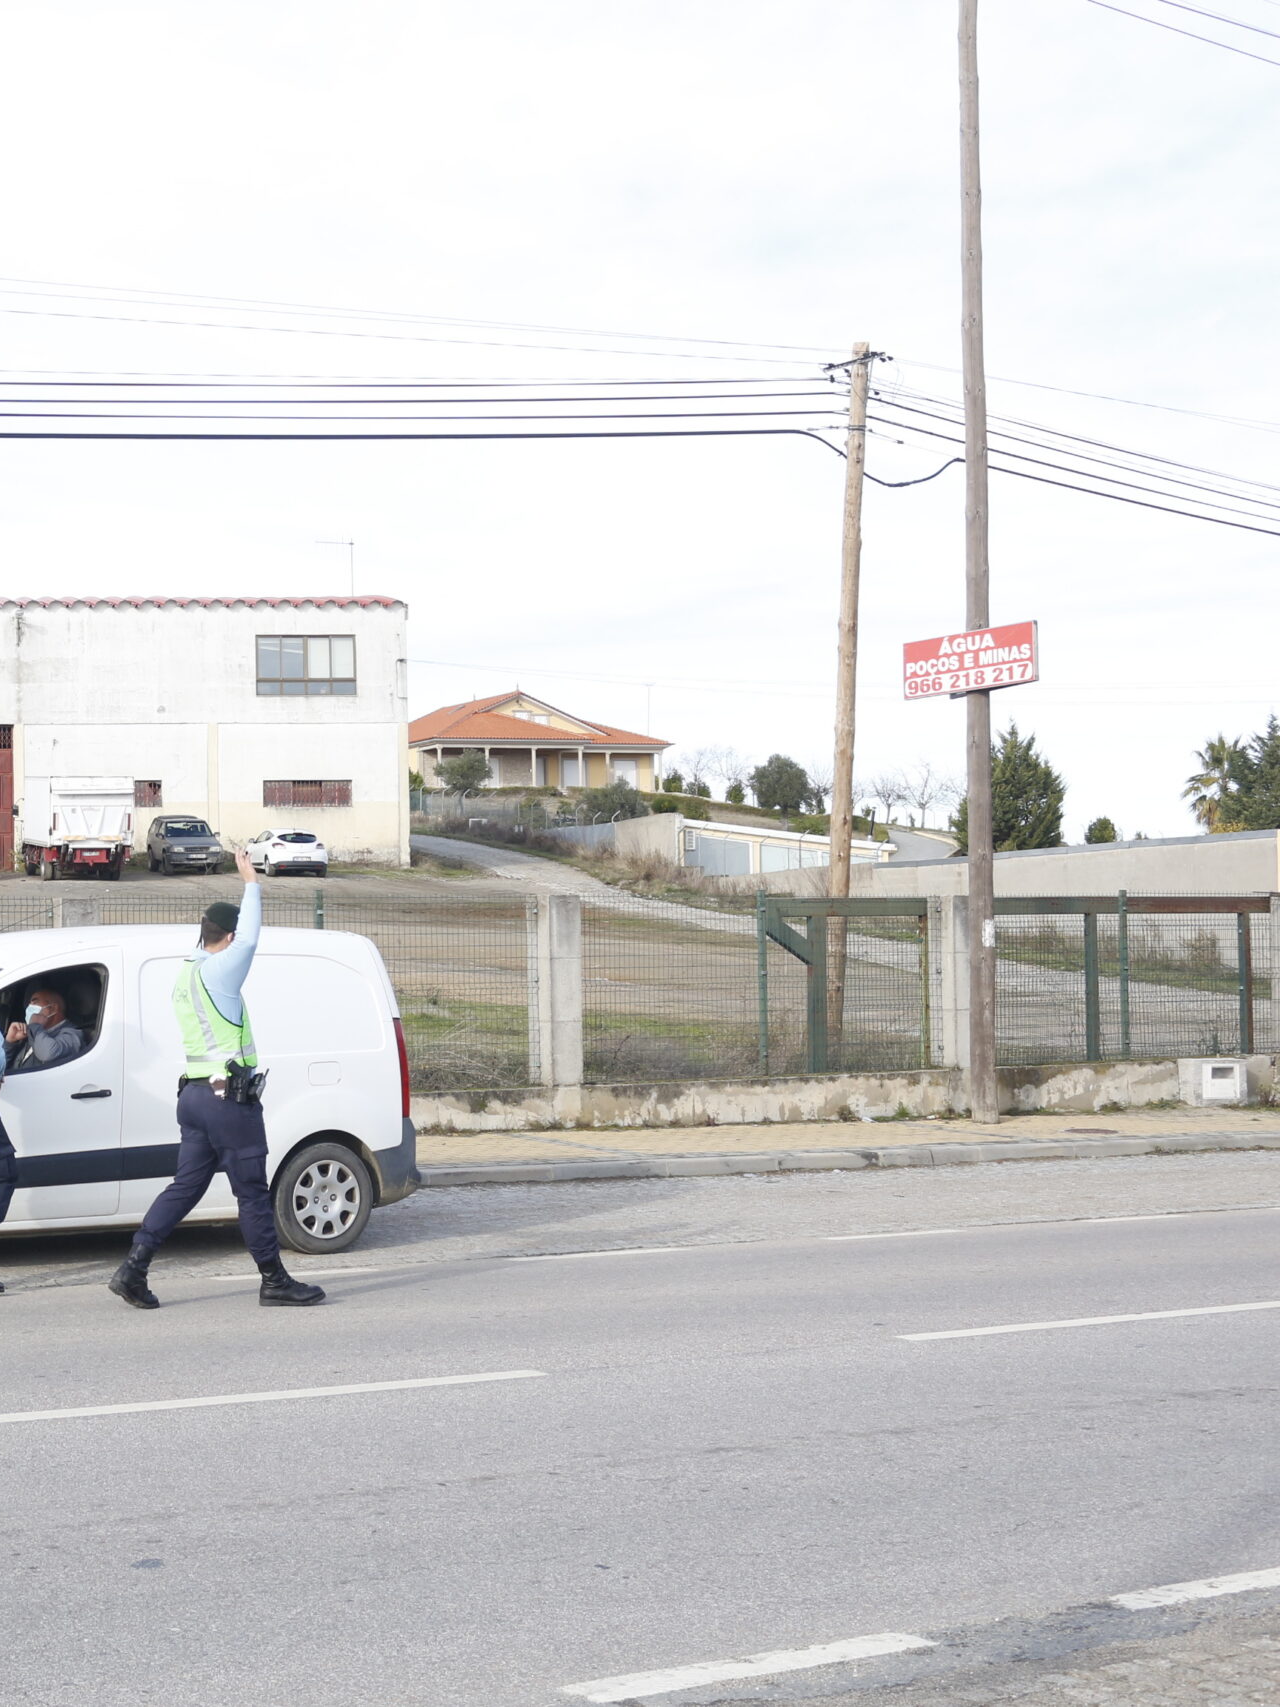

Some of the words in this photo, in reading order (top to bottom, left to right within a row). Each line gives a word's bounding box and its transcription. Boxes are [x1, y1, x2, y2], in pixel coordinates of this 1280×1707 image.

[939, 633, 995, 655] ÁGUA
[906, 655, 960, 677] POÇOS
[964, 653, 975, 668] E
[978, 644, 1031, 666] MINAS
[908, 677, 943, 695] 966
[949, 670, 986, 689] 218
[992, 663, 1029, 682] 217
